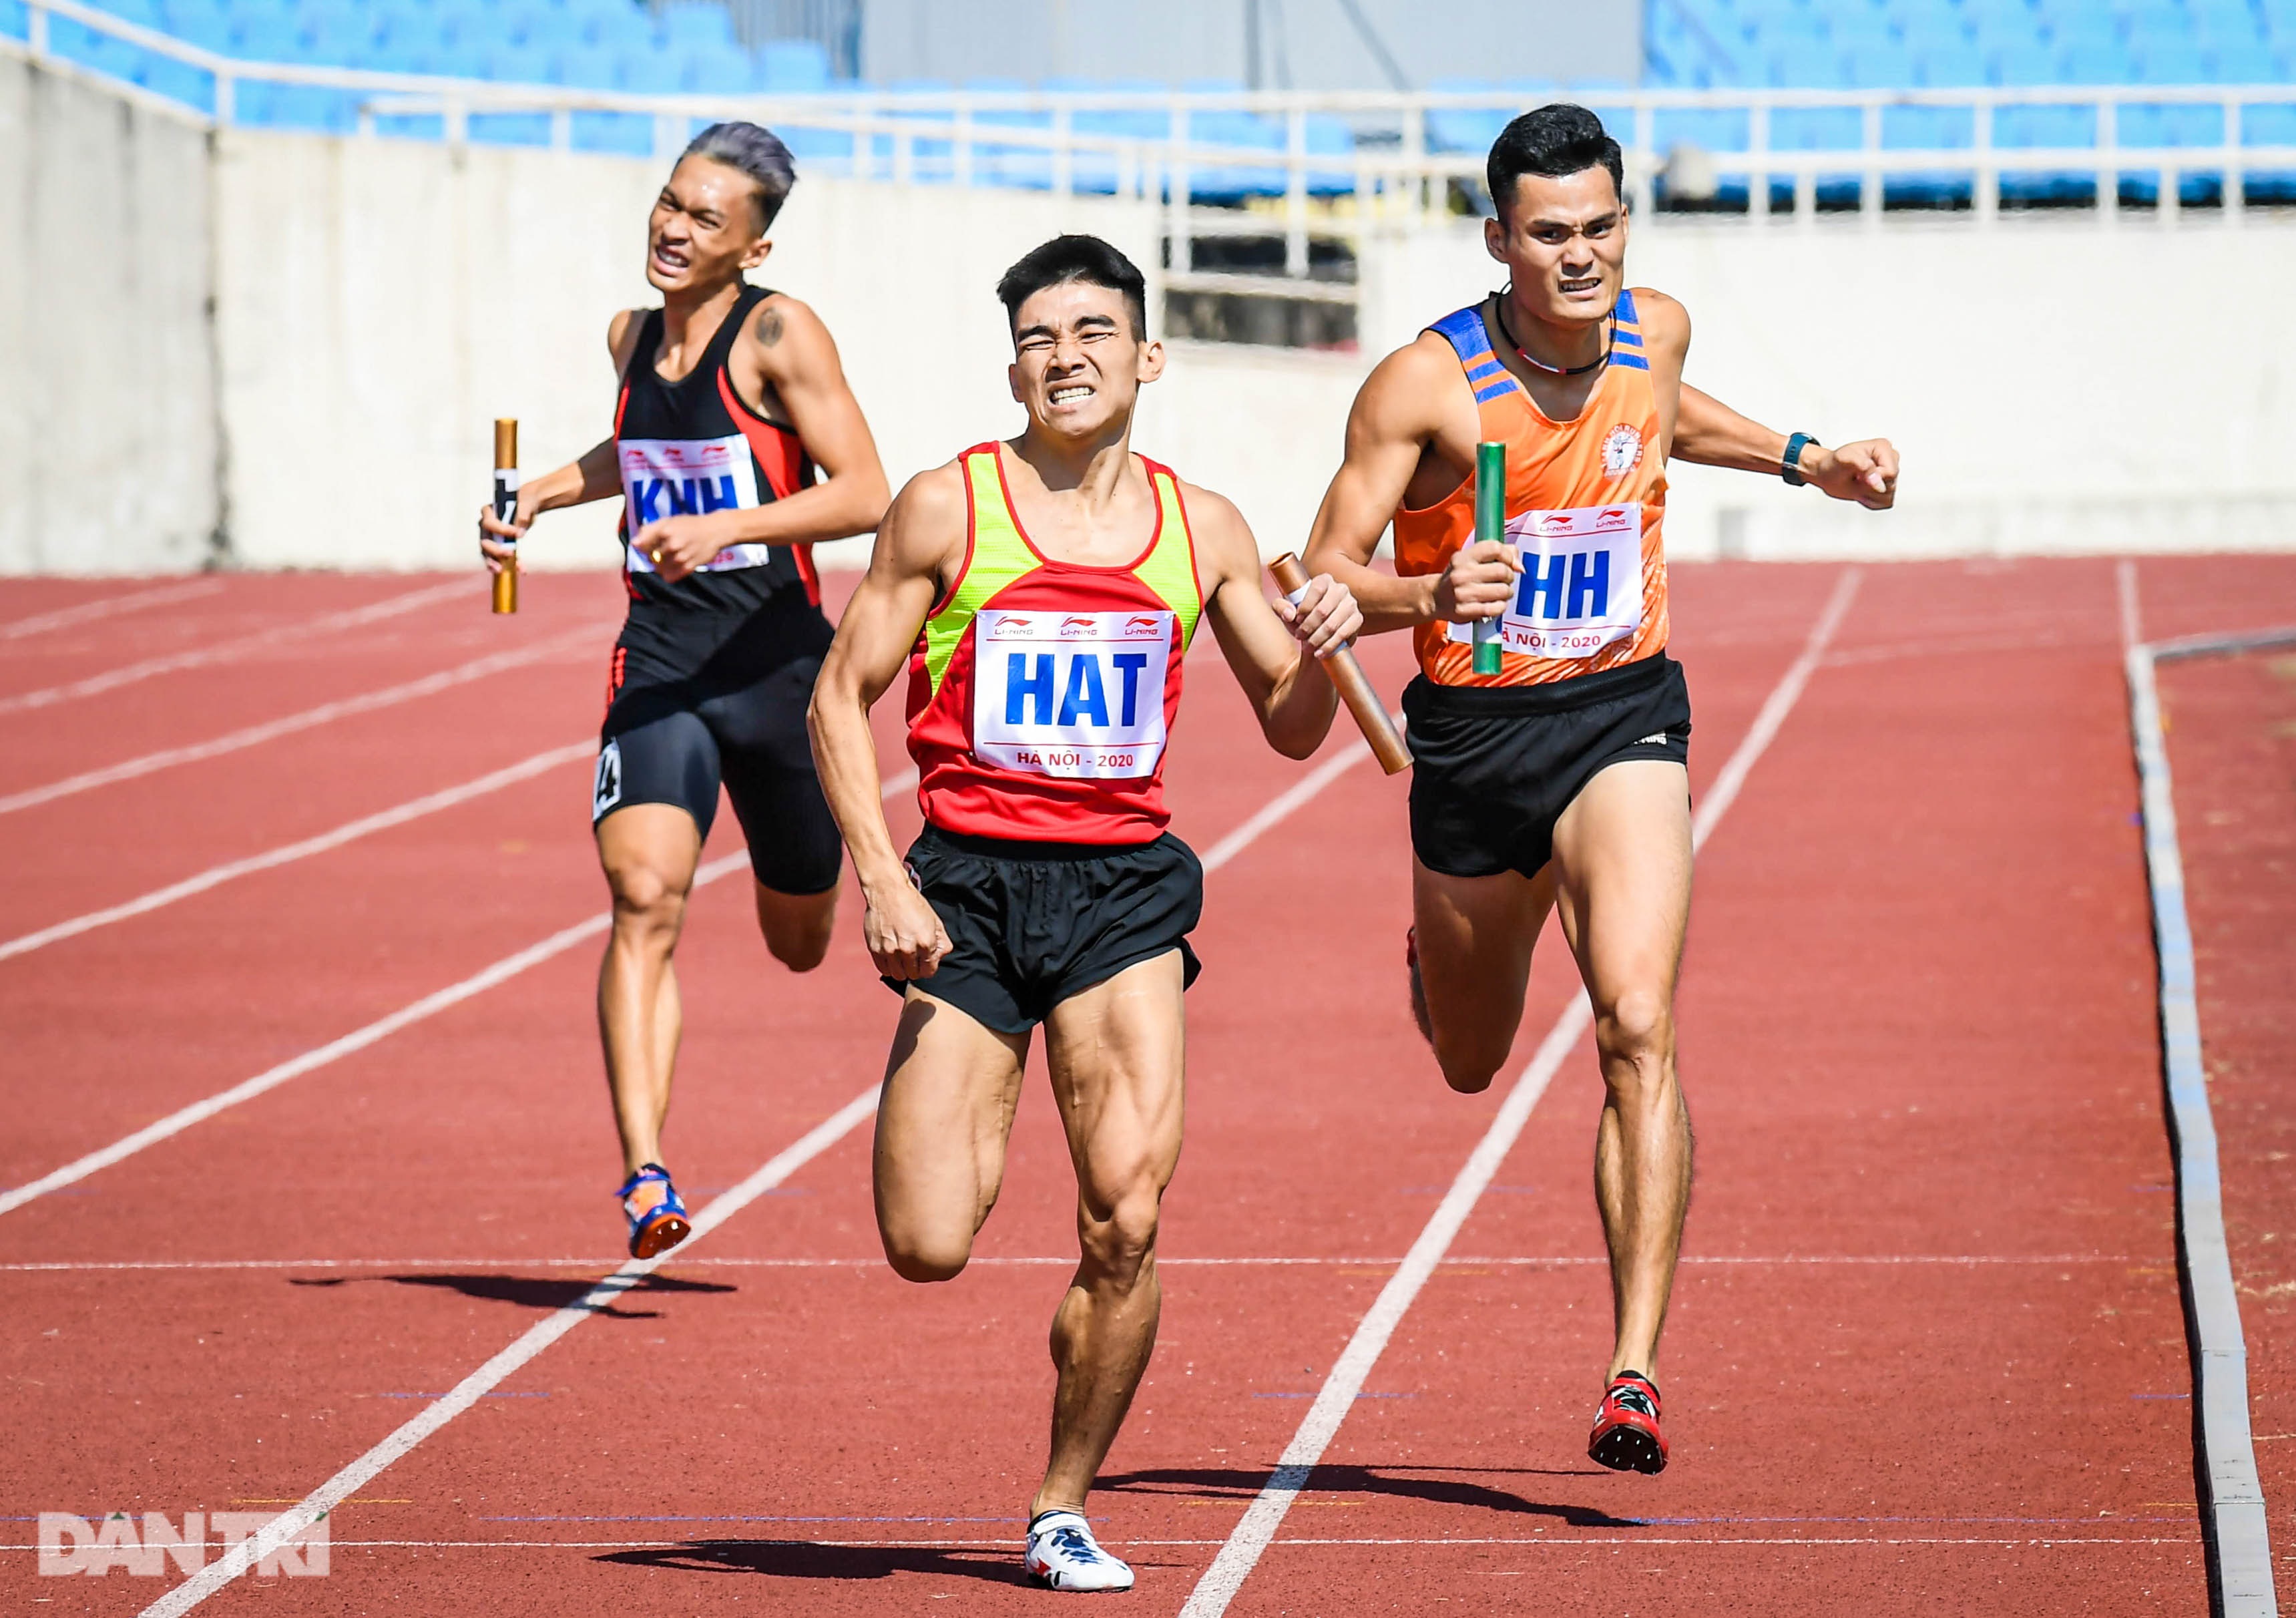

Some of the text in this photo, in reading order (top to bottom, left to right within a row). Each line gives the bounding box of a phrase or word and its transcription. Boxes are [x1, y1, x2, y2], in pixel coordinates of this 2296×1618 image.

[1596, 520, 1626, 528] LI-NING
[1515, 550, 1610, 620] HH
[1516, 632, 1546, 650] NỘI
[1561, 635, 1601, 648] 2020
[1005, 652, 1148, 727] HAT
[1017, 750, 1042, 766] HÀ
[1049, 750, 1080, 770] NỘI
[1098, 755, 1134, 767] 2020
